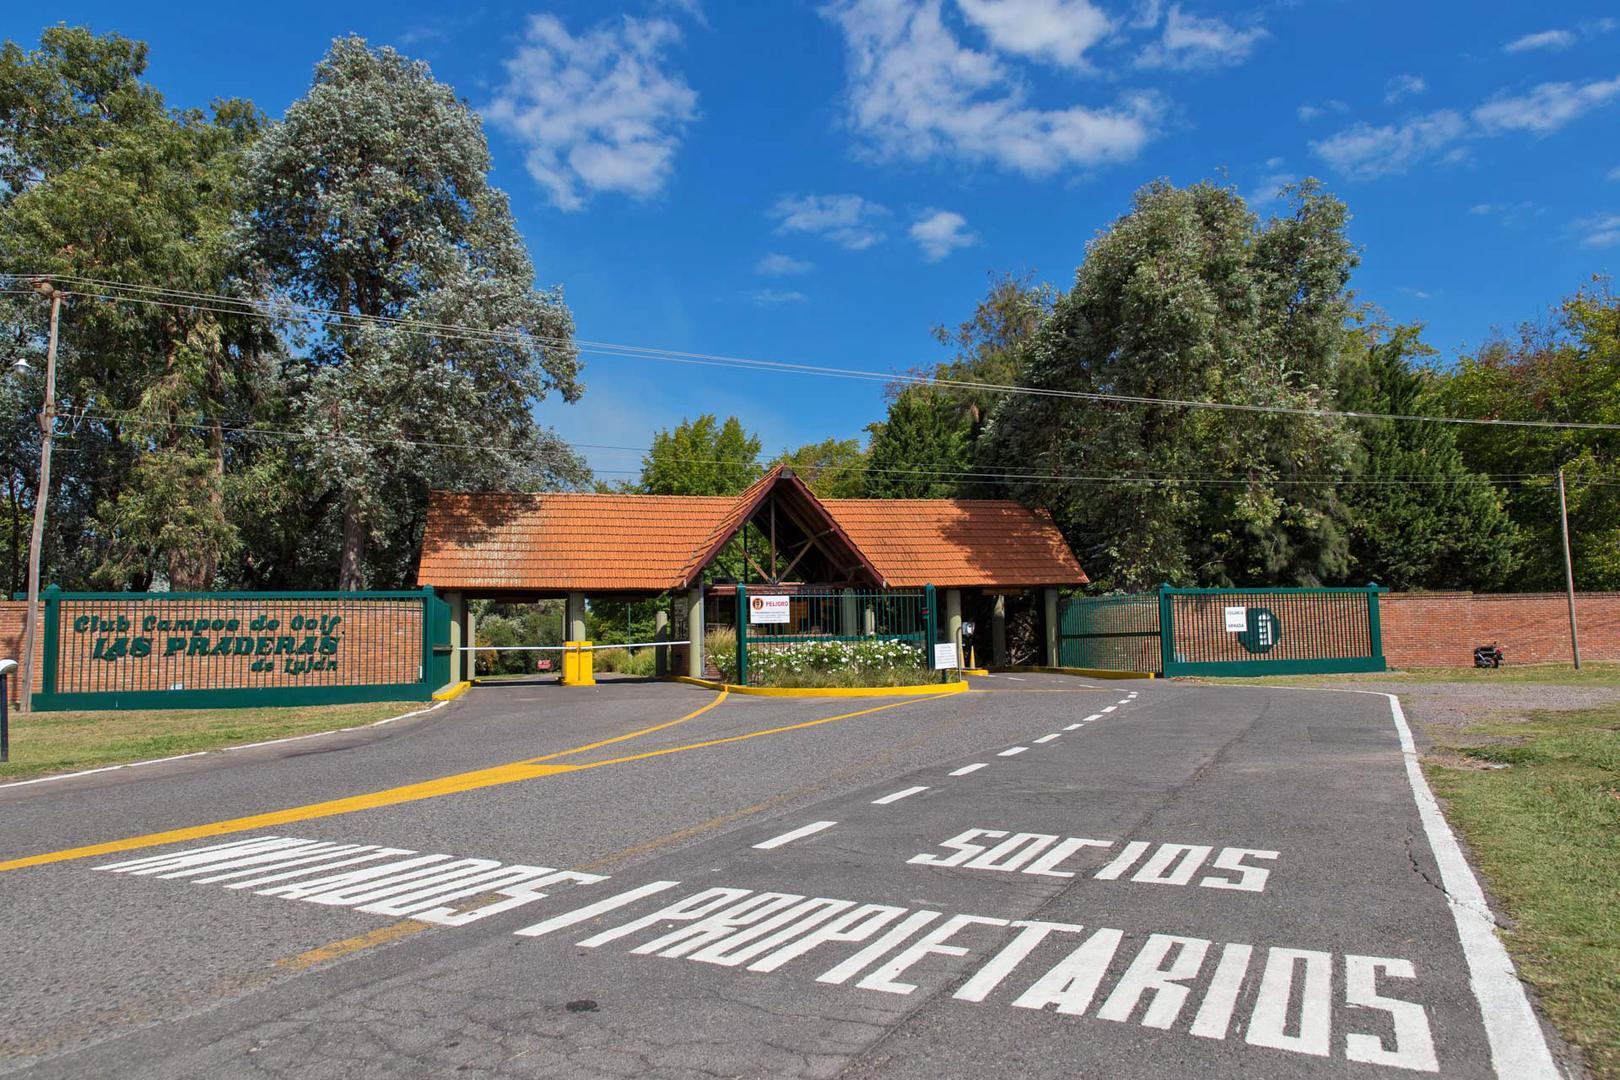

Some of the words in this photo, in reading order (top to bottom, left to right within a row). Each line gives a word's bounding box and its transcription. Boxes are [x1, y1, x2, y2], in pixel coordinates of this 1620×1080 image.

[74, 615, 130, 633] Club
[142, 614, 240, 636] Campos
[249, 614, 280, 631] de
[291, 614, 341, 635] Golf
[92, 637, 153, 661] LAS
[162, 636, 340, 657] PRADERAS
[250, 659, 275, 672] de
[91, 835, 611, 927] INVITADOS
[906, 828, 1280, 893] SOCIOS
[575, 887, 1440, 1073] PROPIETARIOS
